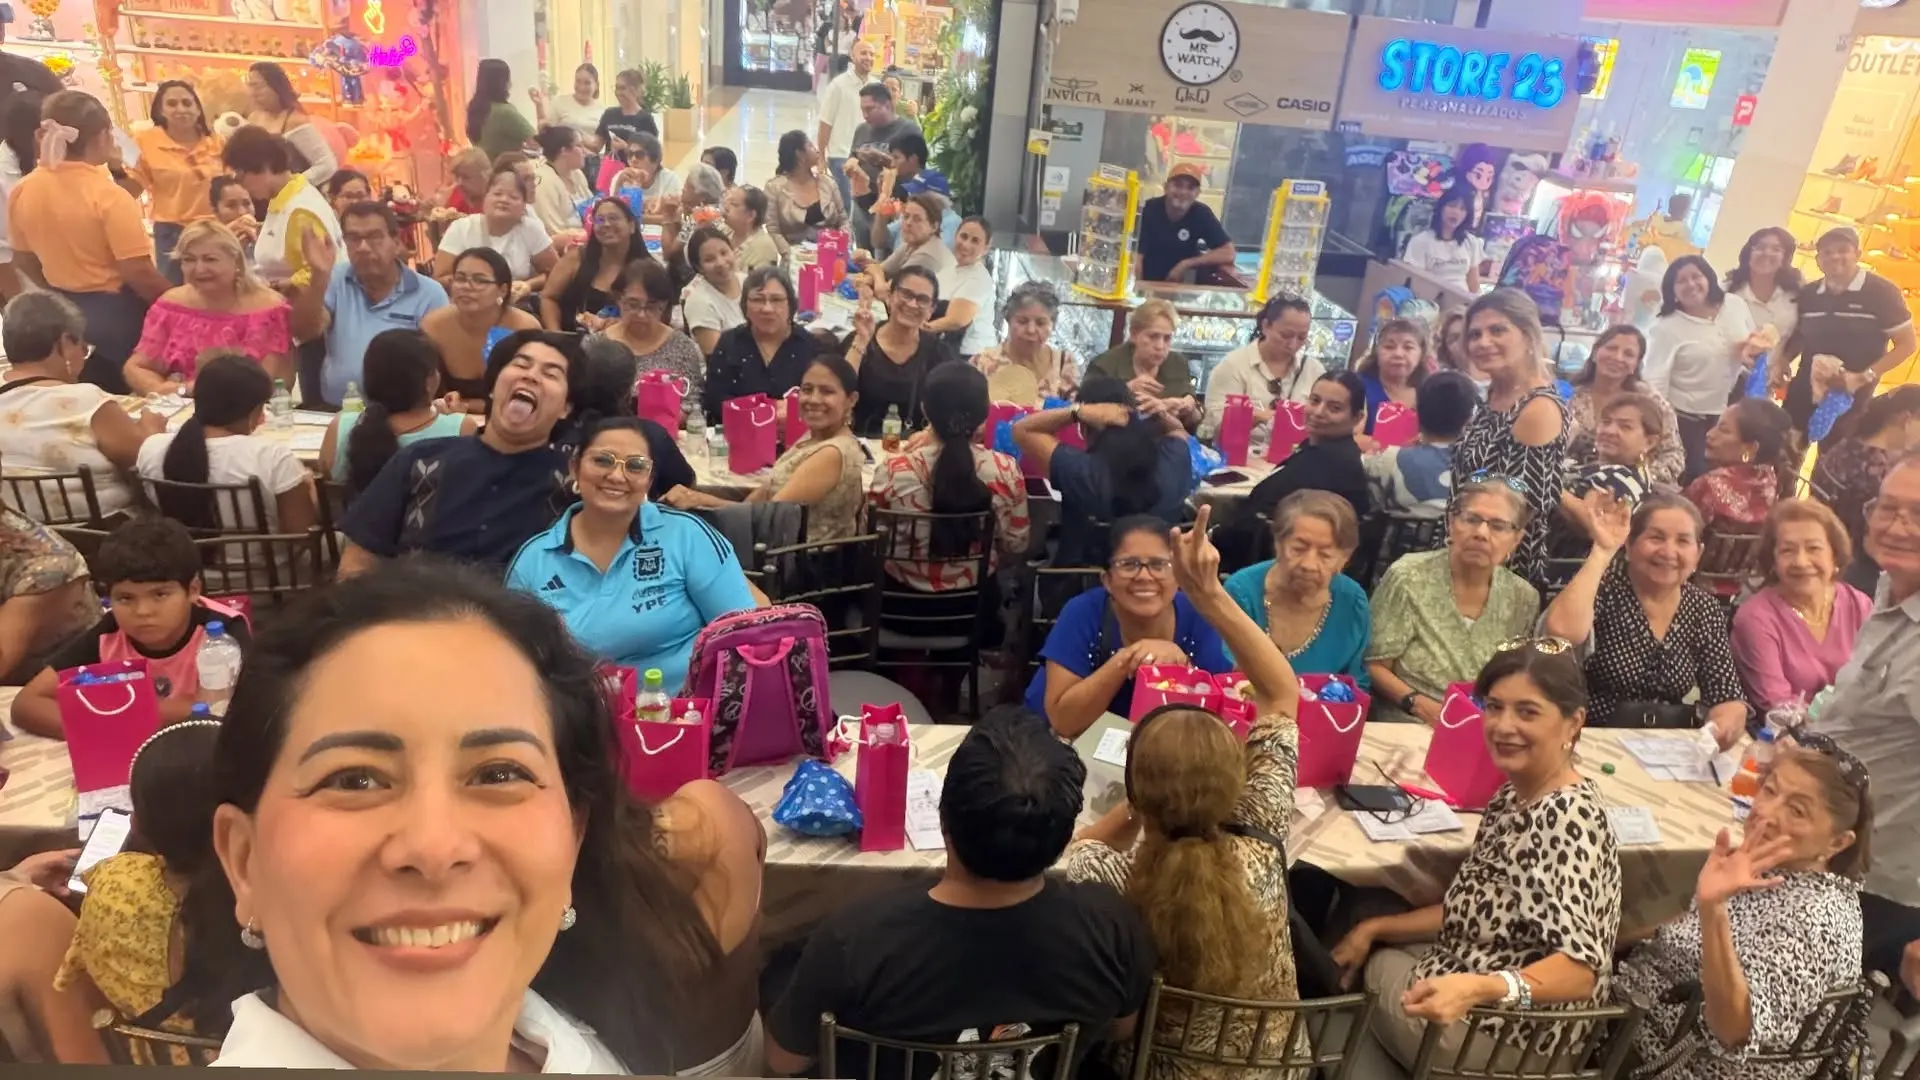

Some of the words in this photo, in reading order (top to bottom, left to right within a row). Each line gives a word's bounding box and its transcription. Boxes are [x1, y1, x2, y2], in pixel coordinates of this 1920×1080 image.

[1189, 42, 1209, 53] MR
[1178, 53, 1220, 66] WATCH
[1379, 38, 1510, 101] STORE
[1046, 88, 1102, 104] INVICTA
[1277, 97, 1331, 112] CASIO
[1401, 98, 1526, 119] PERSONALIZADOS
